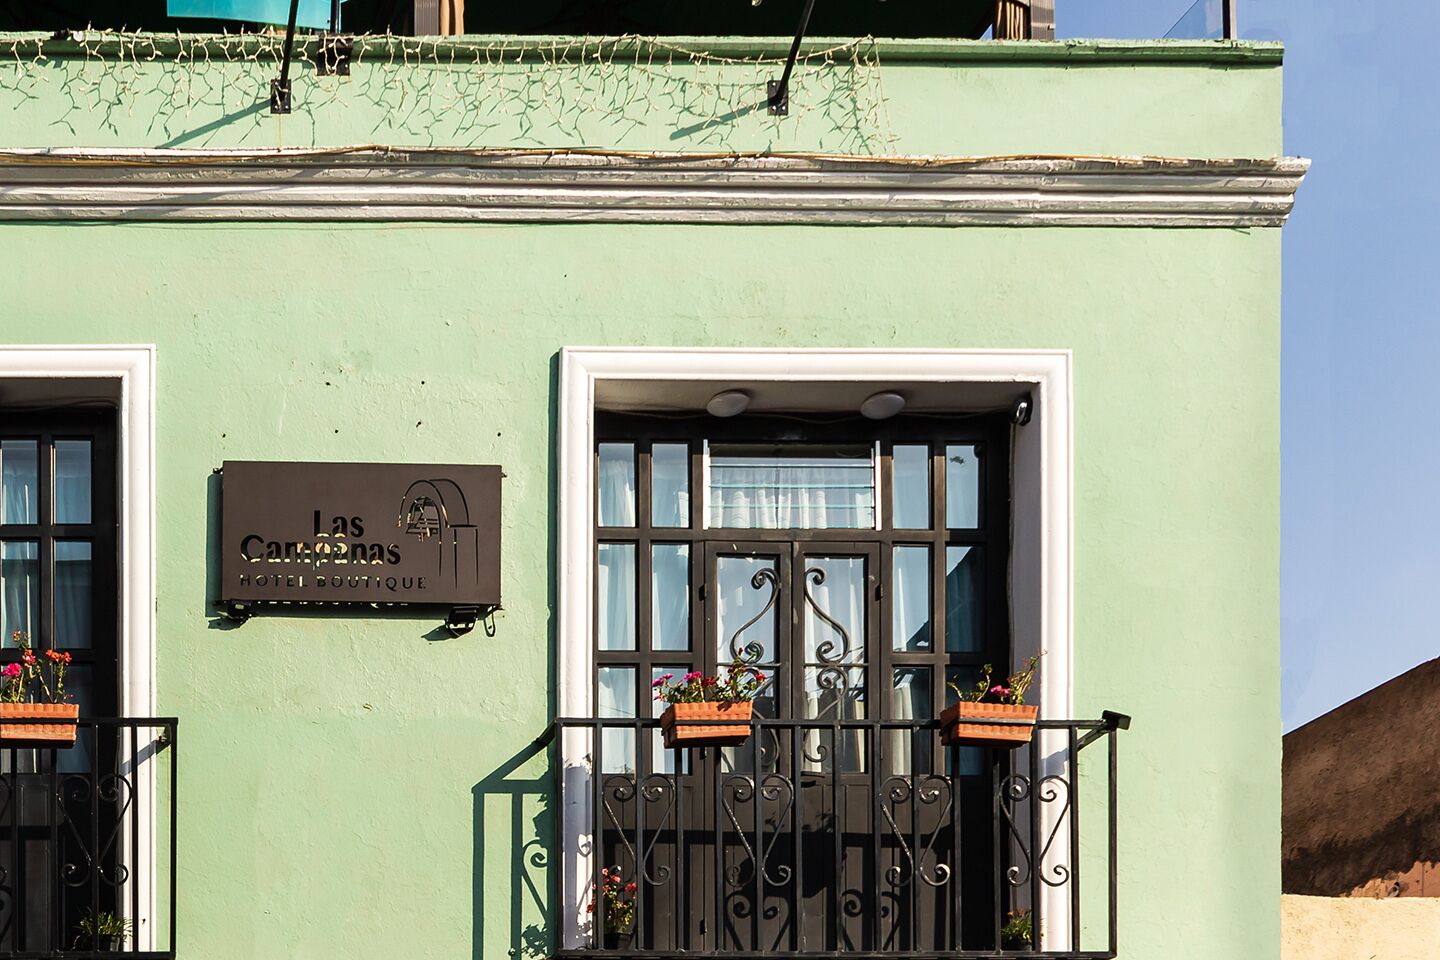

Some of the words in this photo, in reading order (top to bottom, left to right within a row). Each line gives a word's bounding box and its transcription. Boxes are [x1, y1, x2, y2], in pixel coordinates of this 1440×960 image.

[313, 509, 364, 538] Las
[240, 534, 401, 571] Campanas
[239, 574, 308, 588] HOTEL
[316, 574, 426, 592] BOUTIQUE
